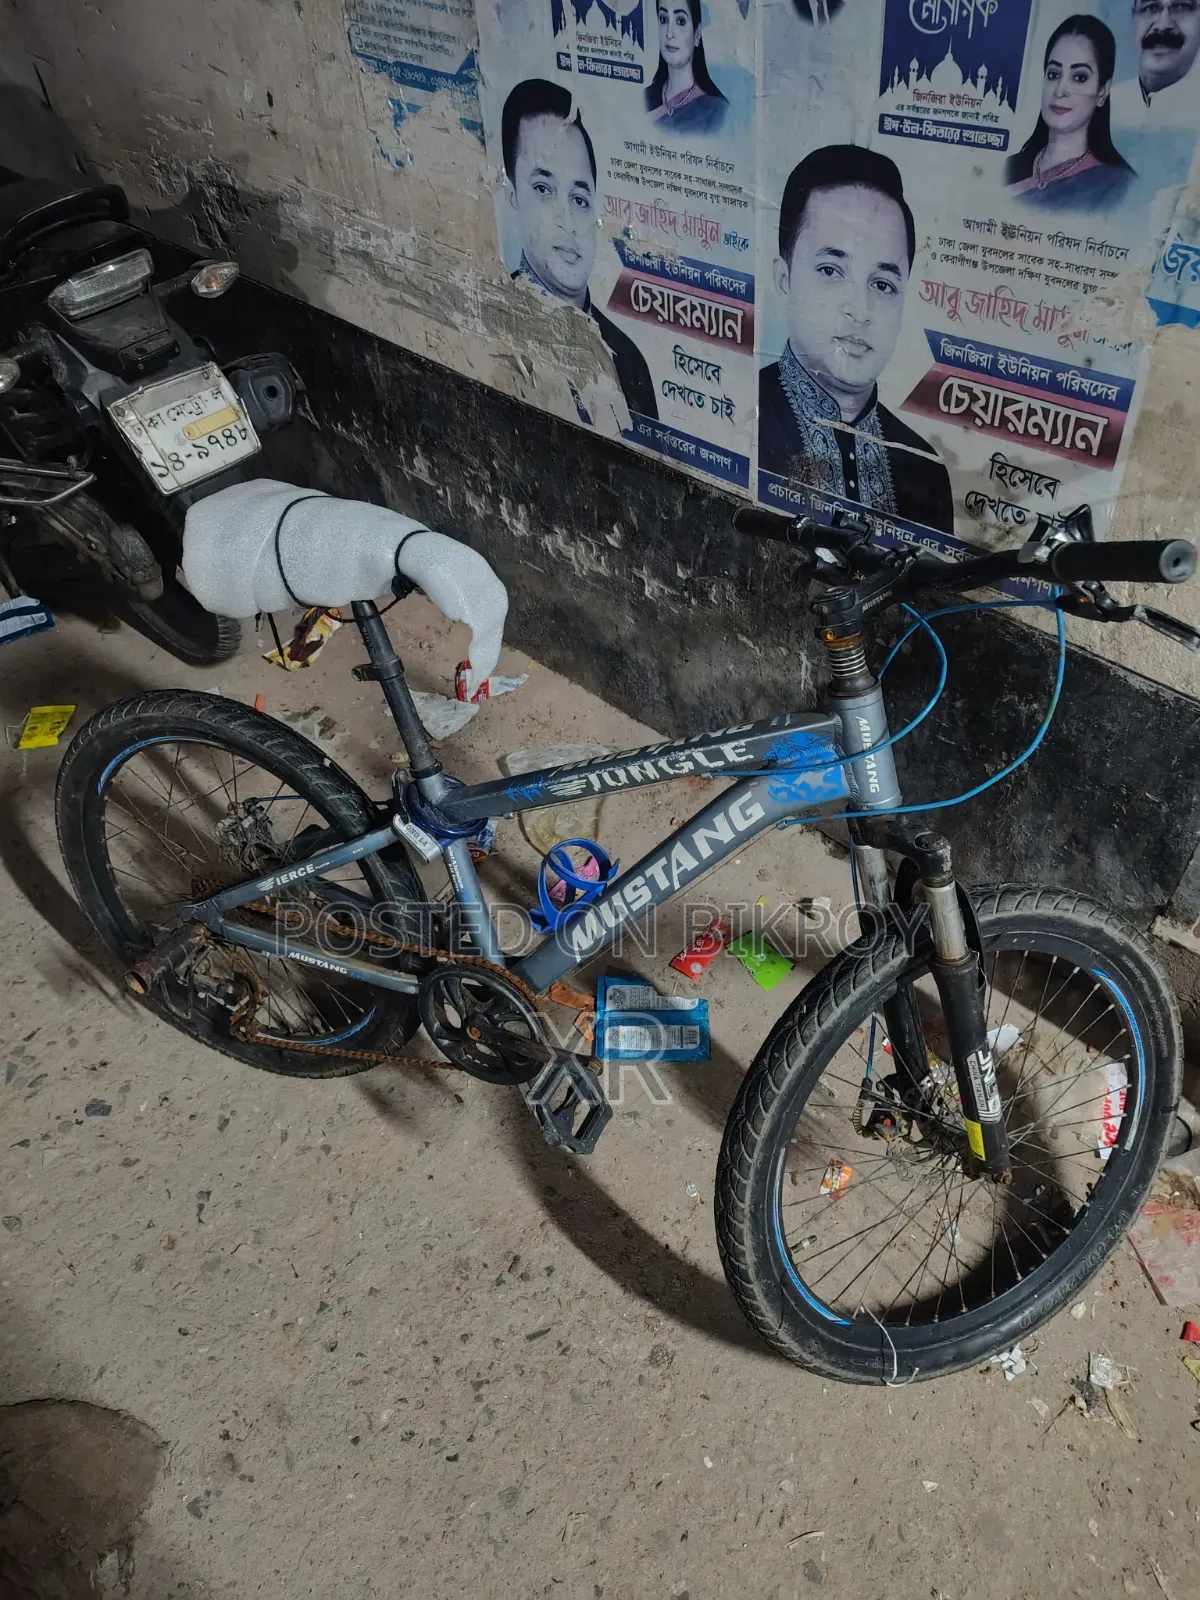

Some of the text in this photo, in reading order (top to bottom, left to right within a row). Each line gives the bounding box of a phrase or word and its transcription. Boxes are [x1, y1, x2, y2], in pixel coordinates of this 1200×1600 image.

[912, 88, 983, 109] জিনজিরা ইউনিয়ন
[623, 140, 735, 174] আগামী ইউনিয়ন পরিষদ নির্বাচনে
[681, 210, 720, 250] মামুন
[938, 237, 955, 250] ঢাকা
[958, 242, 978, 254] জেলা
[981, 246, 1014, 261] যুবদলের
[1017, 252, 1044, 267] সাবেক
[963, 218, 1130, 262] আগামী ইউনিয়ন পরিষদ নির্বাচনে
[704, 269, 748, 295] পরিষদের
[981, 260, 1015, 278] উপজেলা
[1018, 268, 1041, 283] দক্ষিণ
[1043, 275, 1079, 291] যুবদলের
[630, 278, 744, 344] চেয়ারম্যান
[918, 279, 962, 322] আবু
[965, 285, 1032, 335] জাহিদ
[672, 344, 722, 385] হিসেবে
[940, 338, 1121, 402] জিনজিরা ইউনিয়ন পরিষদের
[661, 380, 736, 426] দেখতে চাই
[938, 375, 1109, 457] চেয়ারম্যান
[637, 423, 652, 439] এর
[655, 429, 696, 456] সর্বস্তরের
[699, 446, 732, 470] জনগণ
[989, 452, 1061, 501] হিসেবে
[965, 490, 1030, 526] দেখতে
[580, 739, 756, 793] JUNGLE
[572, 790, 766, 963] MUSTANG
[287, 951, 348, 976] MUSTANG
[969, 1060, 986, 1108] CHINA TIANJIN
